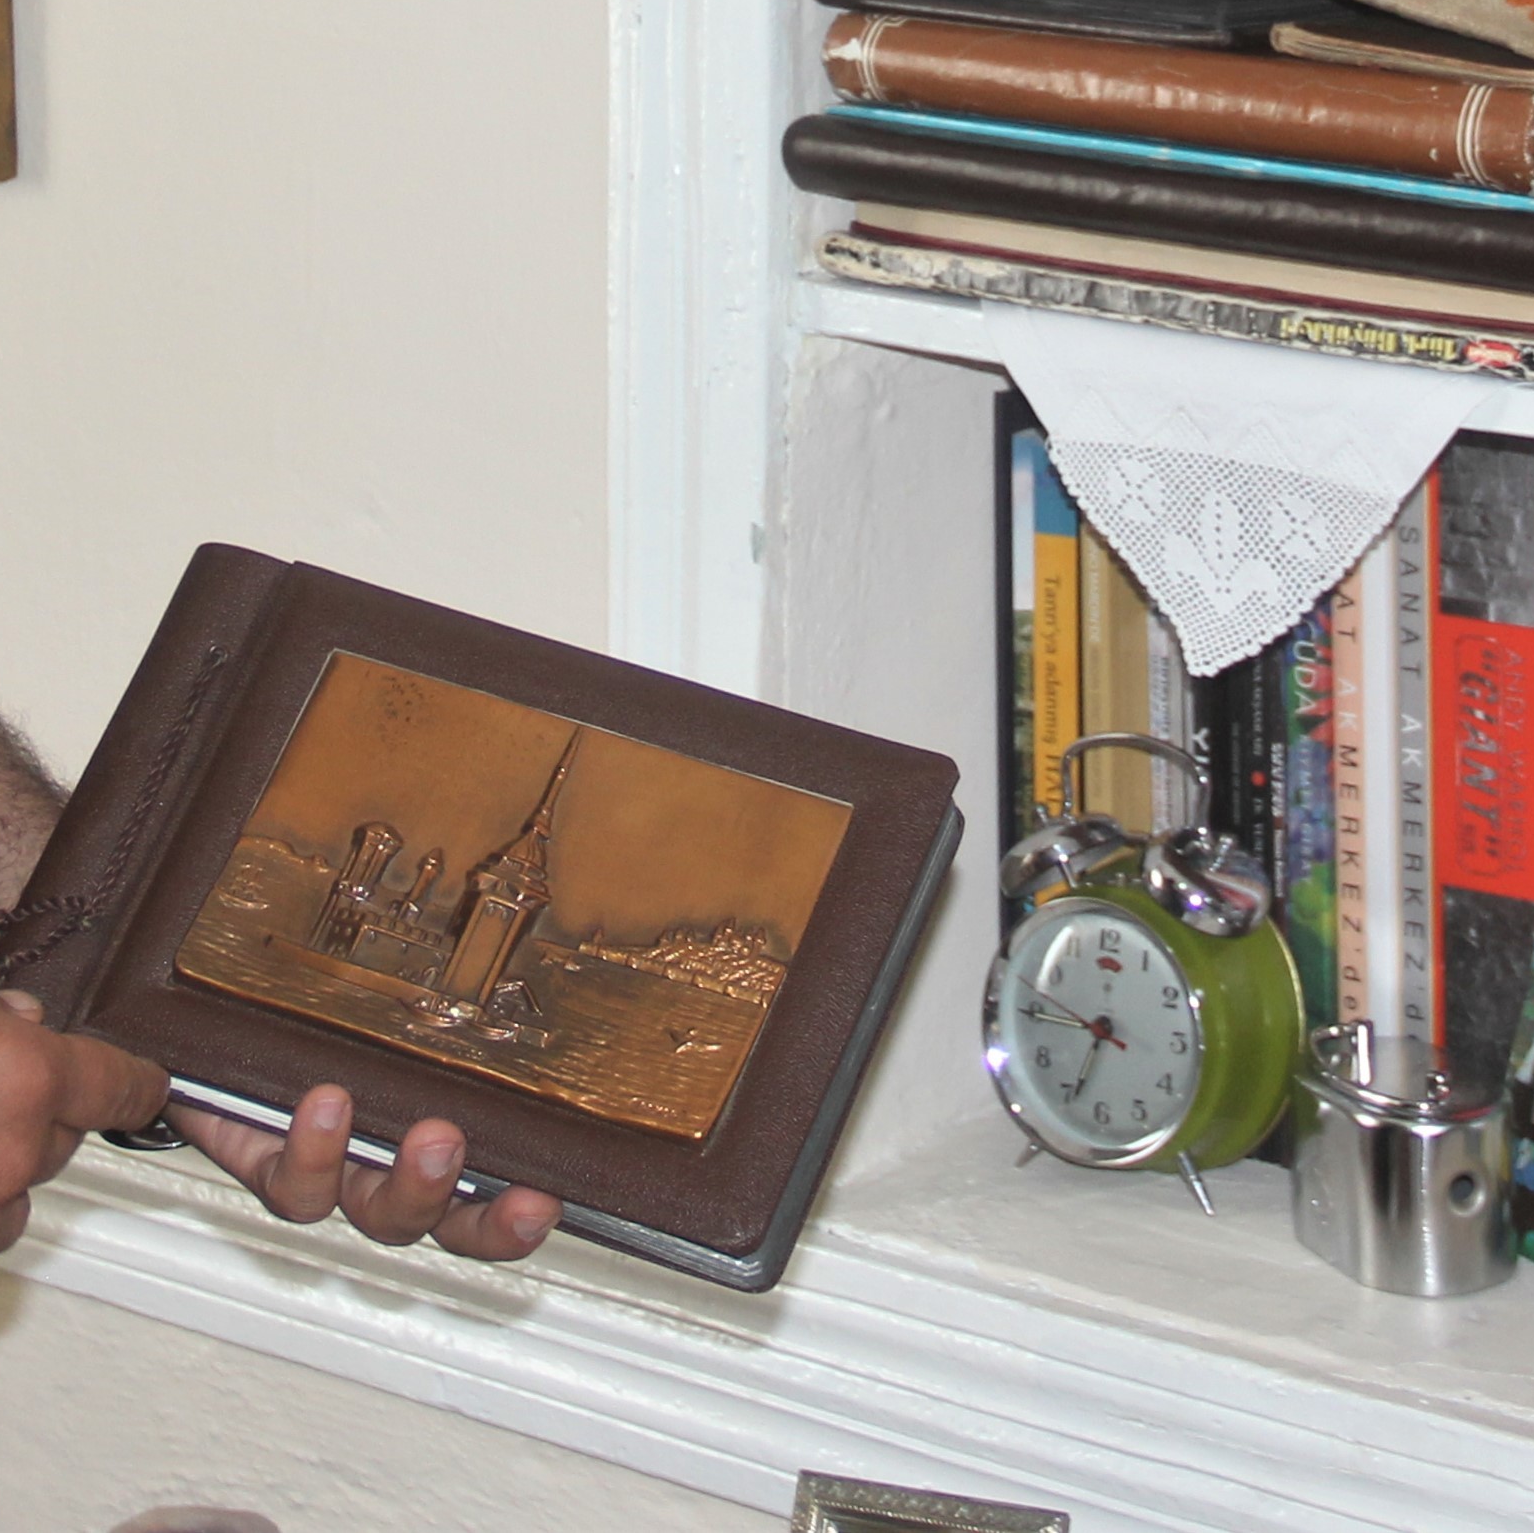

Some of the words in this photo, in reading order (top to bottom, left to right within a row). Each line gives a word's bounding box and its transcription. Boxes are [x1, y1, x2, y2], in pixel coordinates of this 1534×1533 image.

[1336, 574, 1360, 644] AT
[1396, 525, 1424, 682] SANAT
[1042, 661, 1064, 746] adanmış
[1099, 928, 1120, 954] 12
[1141, 949, 1149, 971] 1
[1162, 985, 1178, 1010] 2
[1169, 1031, 1186, 1054] 3
[1035, 1045, 1051, 1068] 8
[1060, 1082, 1074, 1103] 7
[1156, 1072, 1173, 1095] 4
[1093, 1101, 1111, 1124] 6
[1130, 1098, 1148, 1121] 5
